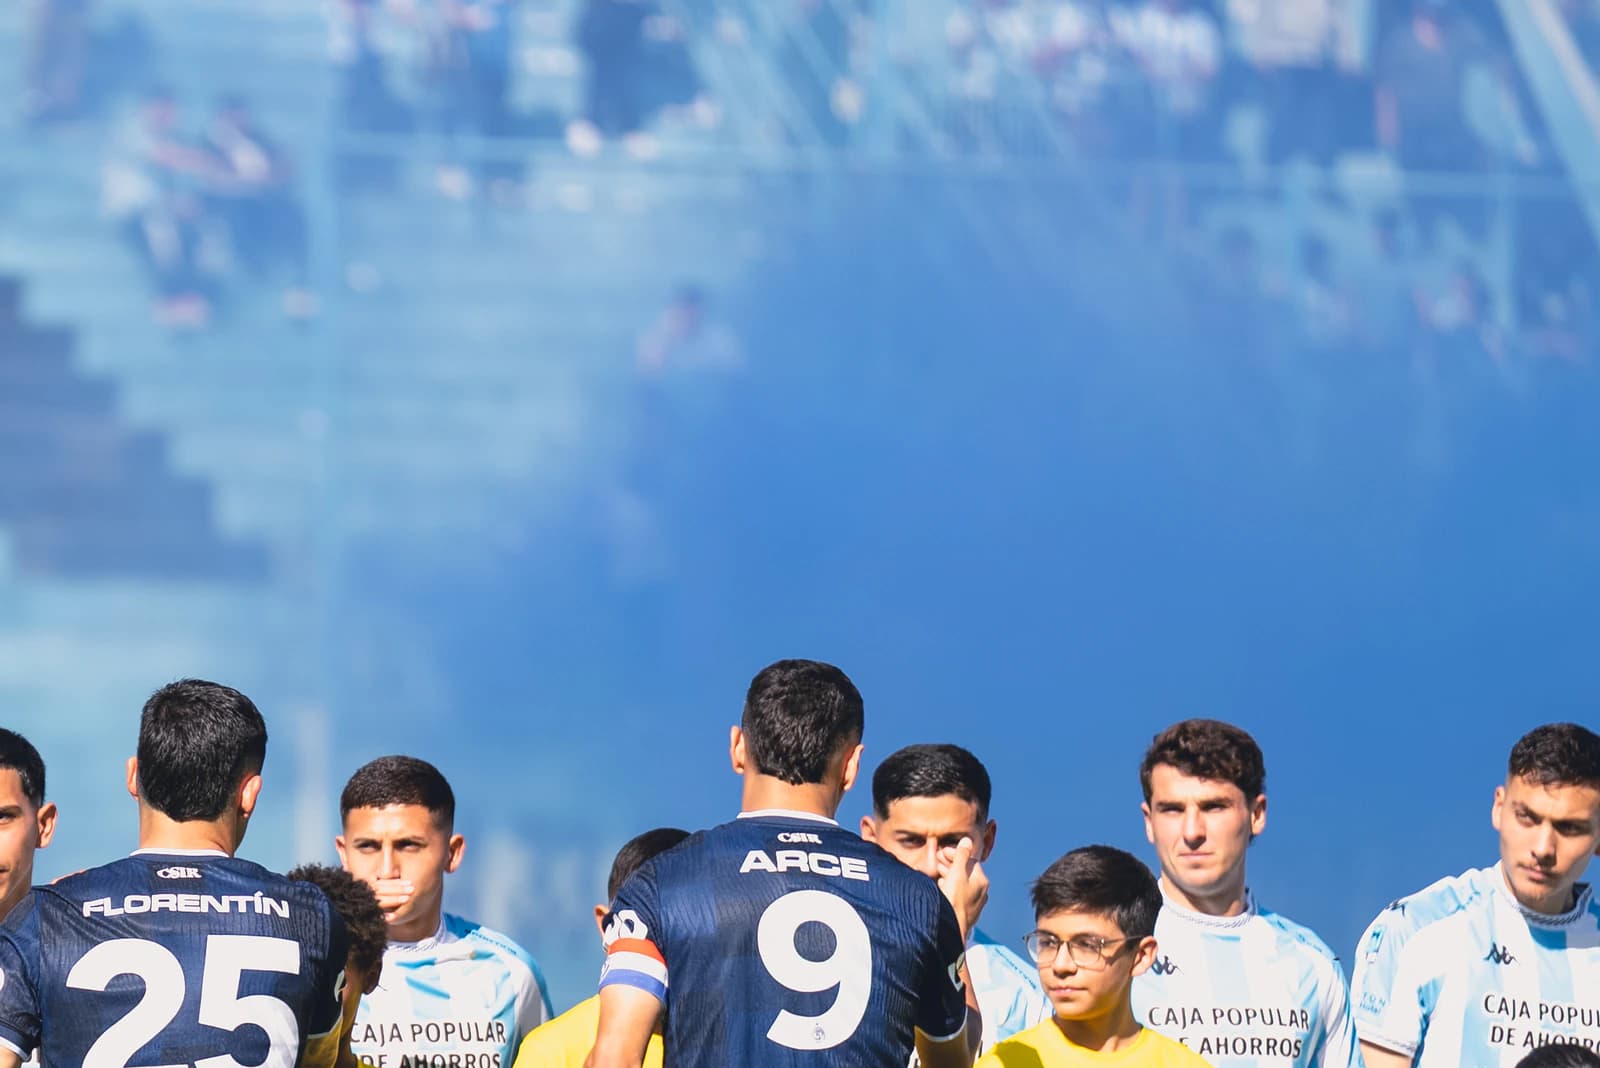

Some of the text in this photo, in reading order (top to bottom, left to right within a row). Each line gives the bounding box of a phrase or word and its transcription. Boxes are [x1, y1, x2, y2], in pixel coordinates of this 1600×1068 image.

[156, 867, 202, 879] CSIR
[739, 850, 870, 881] ARCE
[82, 891, 290, 919] FLORENTÍN
[757, 889, 872, 1050] 9
[1148, 1007, 1310, 1032] CAJA POPULAR
[1483, 994, 1531, 1022] CAJA
[350, 1021, 507, 1045] CAJA POPULAR
[1491, 1026, 1516, 1046] DE
[1199, 1037, 1302, 1058] AHORROS
